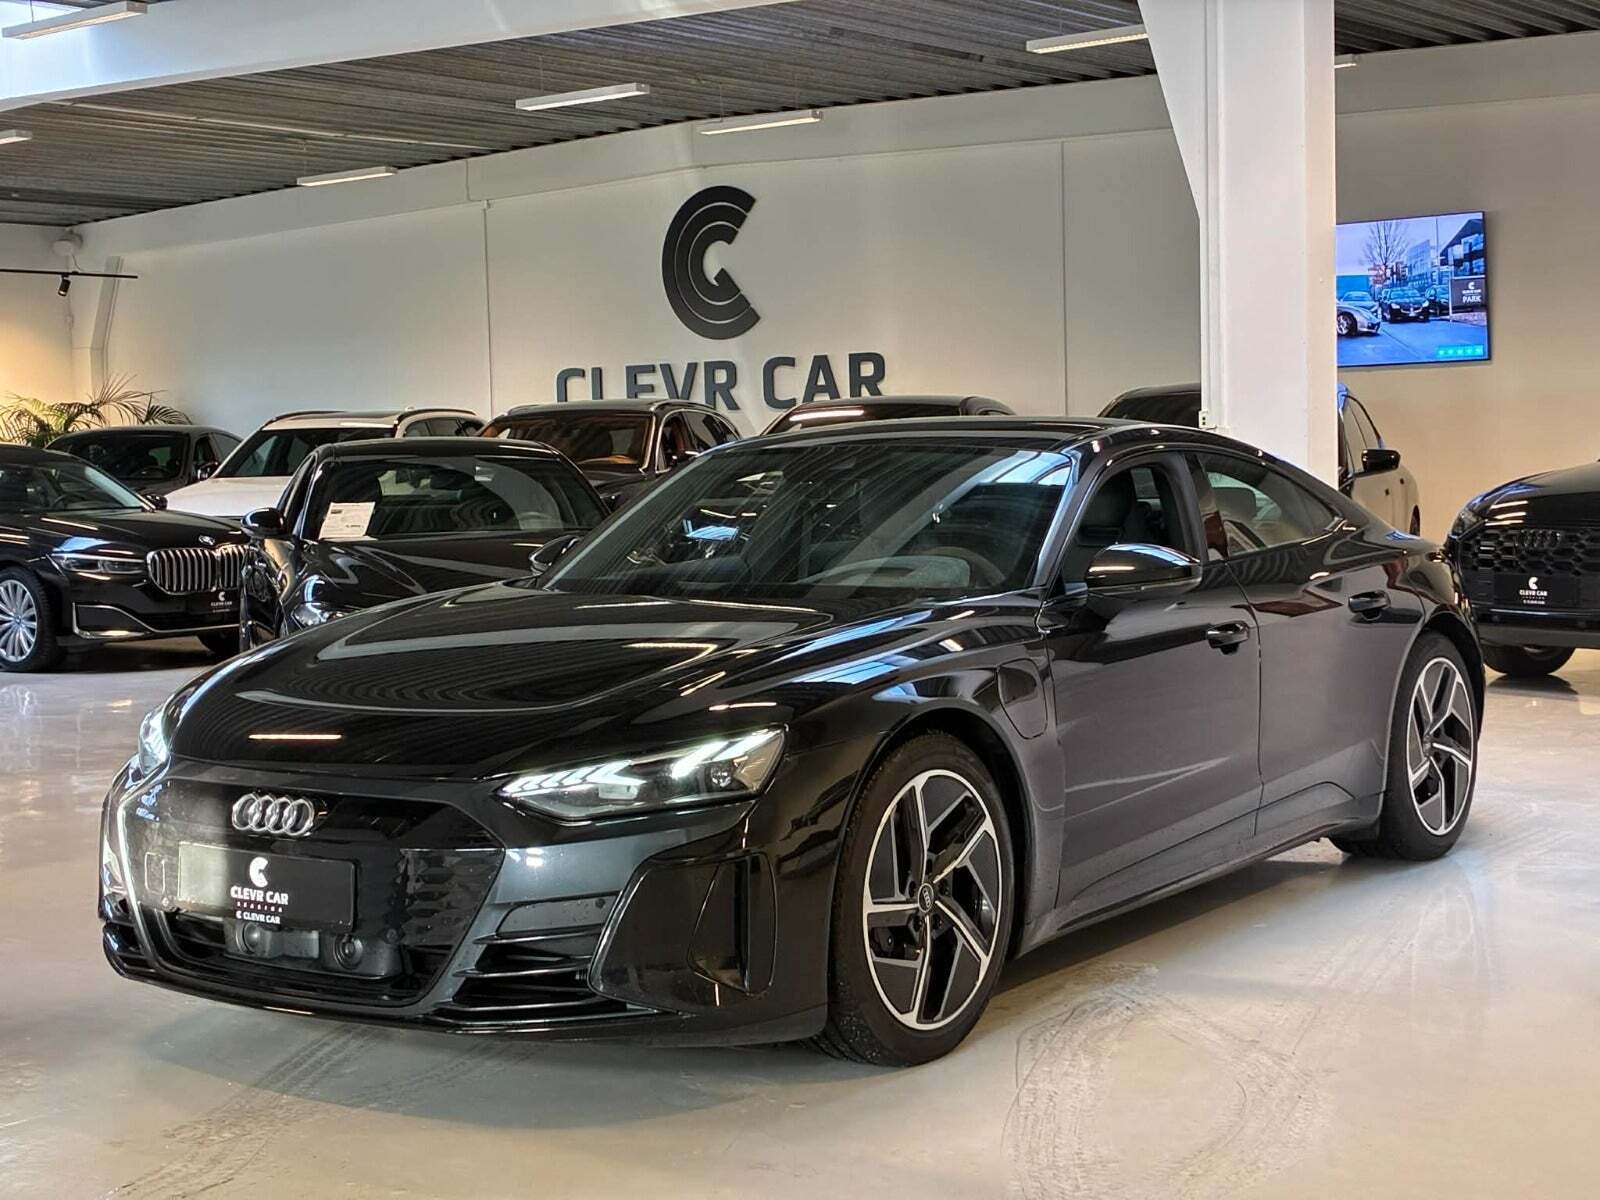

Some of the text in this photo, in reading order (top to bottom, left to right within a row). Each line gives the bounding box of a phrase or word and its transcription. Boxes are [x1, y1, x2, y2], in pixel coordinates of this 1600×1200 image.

[1462, 295, 1481, 303] PARK
[762, 352, 886, 410] CAR
[231, 885, 288, 905] CLEVR CAR
[243, 911, 265, 922] CLEVR
[265, 914, 281, 924] CAR
